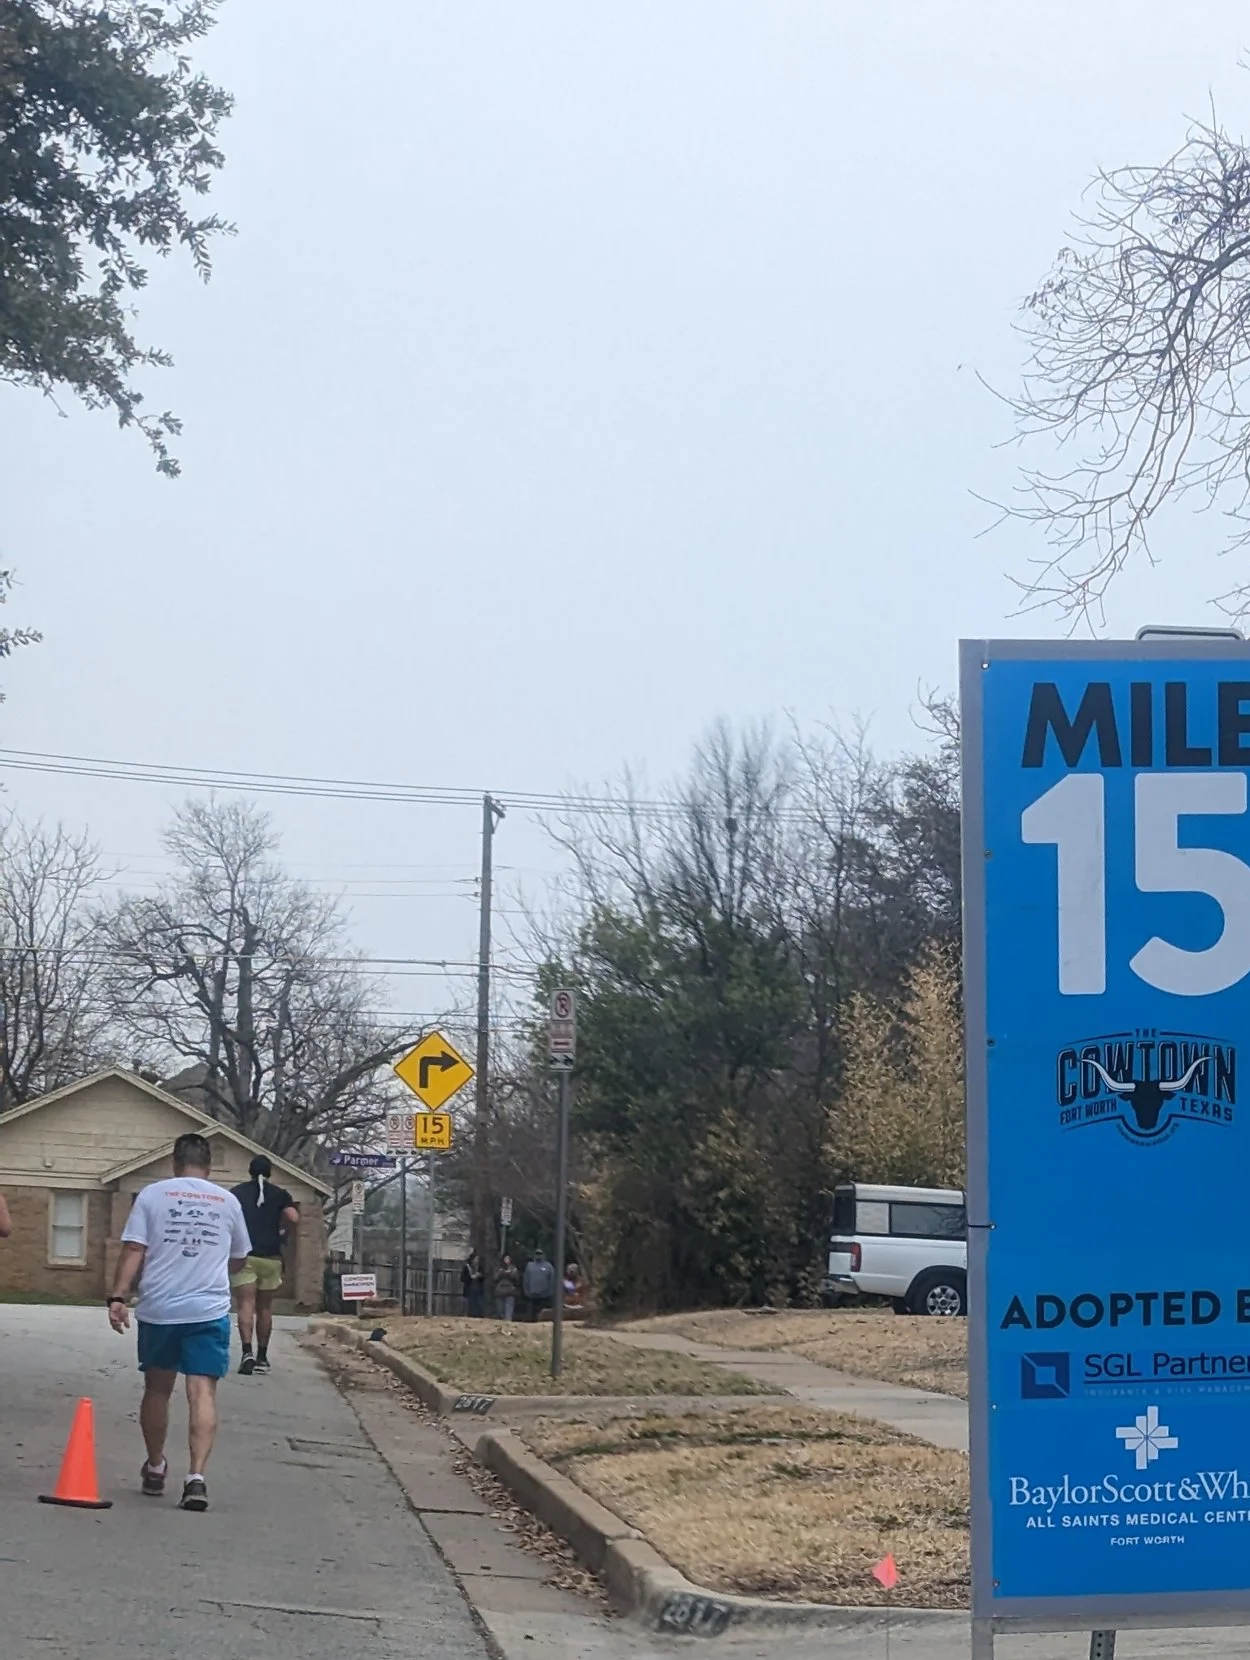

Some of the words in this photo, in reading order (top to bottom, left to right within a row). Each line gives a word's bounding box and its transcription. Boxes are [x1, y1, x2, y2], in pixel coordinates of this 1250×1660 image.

[1134, 1028, 1158, 1038] THE
[1057, 1040, 1237, 1106] COWTOWN
[1060, 1106, 1082, 1125] FORT
[1085, 1099, 1118, 1118] WORTH
[1180, 1097, 1233, 1121] TEXAS
[423, 1116, 444, 1134] 15
[421, 1137, 445, 1145] MPH
[1000, 1290, 1222, 1329] ADOPTED
[1084, 1353, 1142, 1378] SGL
[1026, 1515, 1056, 1528] ALL
[1062, 1514, 1120, 1527] SAINTS
[1126, 1512, 1199, 1526] MEDICAL
[1110, 1537, 1140, 1546] FORT
[1144, 1535, 1185, 1545] WORTH
